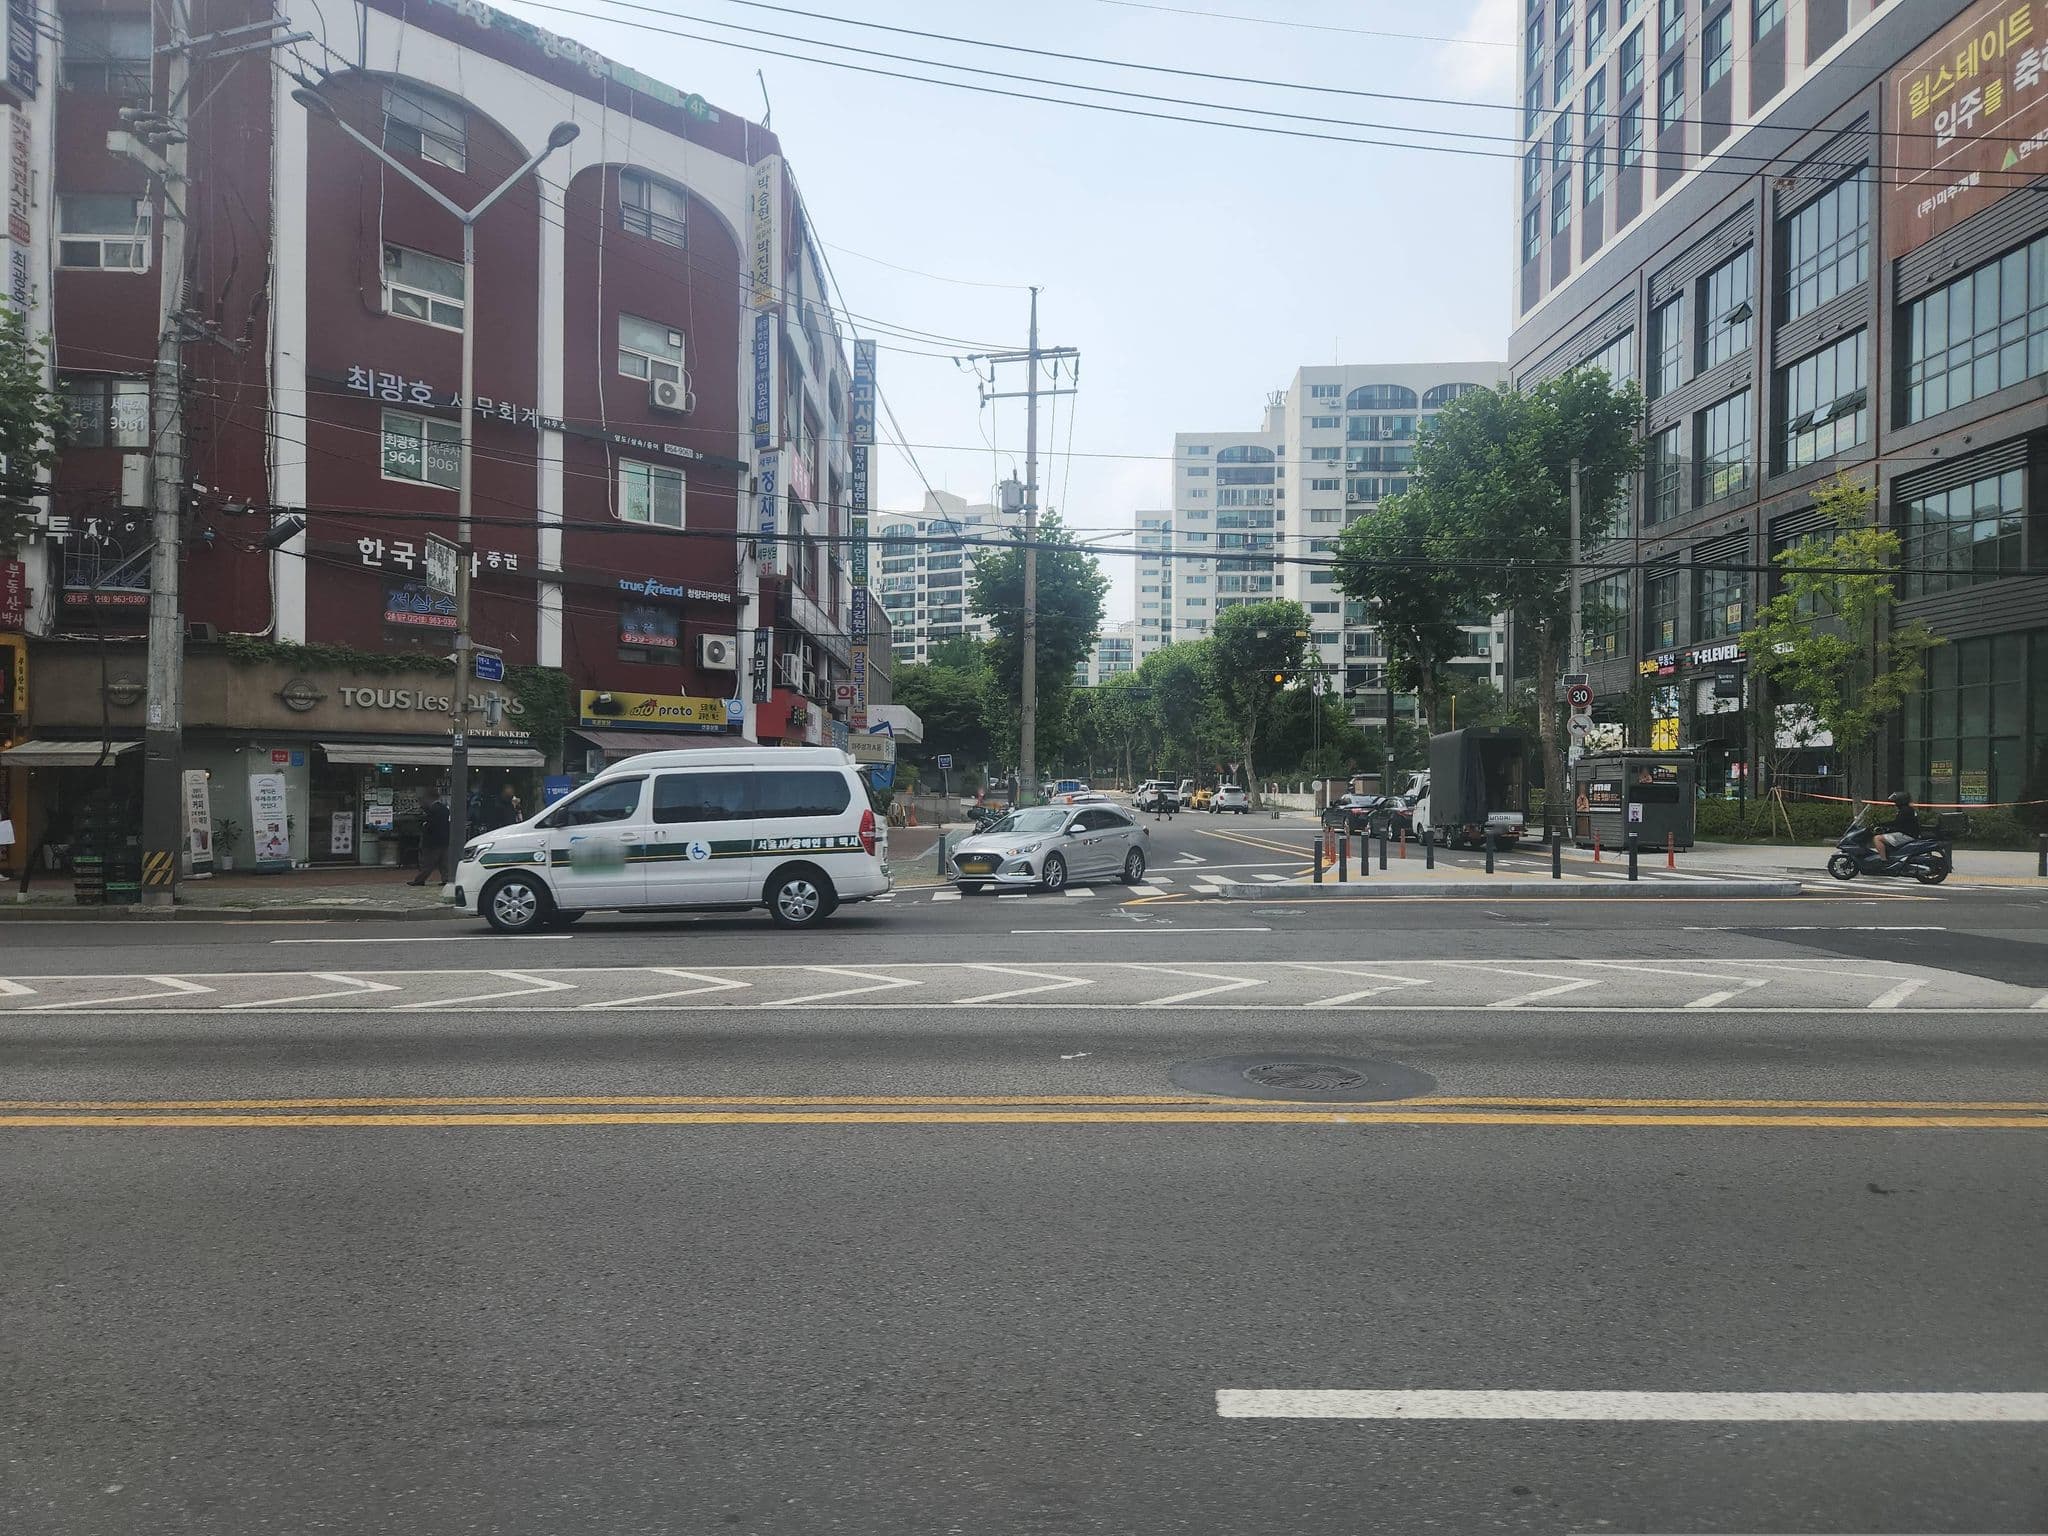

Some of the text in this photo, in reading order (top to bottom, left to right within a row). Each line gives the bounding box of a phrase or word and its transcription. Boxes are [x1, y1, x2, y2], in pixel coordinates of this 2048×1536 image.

[1909, 3, 2034, 120] 힐스테이트
[1934, 78, 2004, 150] 입주를
[347, 365, 436, 409] 최광호
[486, 551, 518, 571] 증권
[761, 562, 773, 575] 3F
[5, 563, 20, 612] 부동산
[2, 612, 24, 627] 박사
[1658, 653, 1675, 667] 부동산
[1692, 643, 1739, 665] 7-ELEVEN
[755, 641, 766, 693] 세무사
[340, 687, 411, 710] TOUS
[415, 690, 449, 712] les
[1573, 690, 1588, 702] 30
[659, 706, 693, 717] proto
[498, 730, 532, 739] BAKERY
